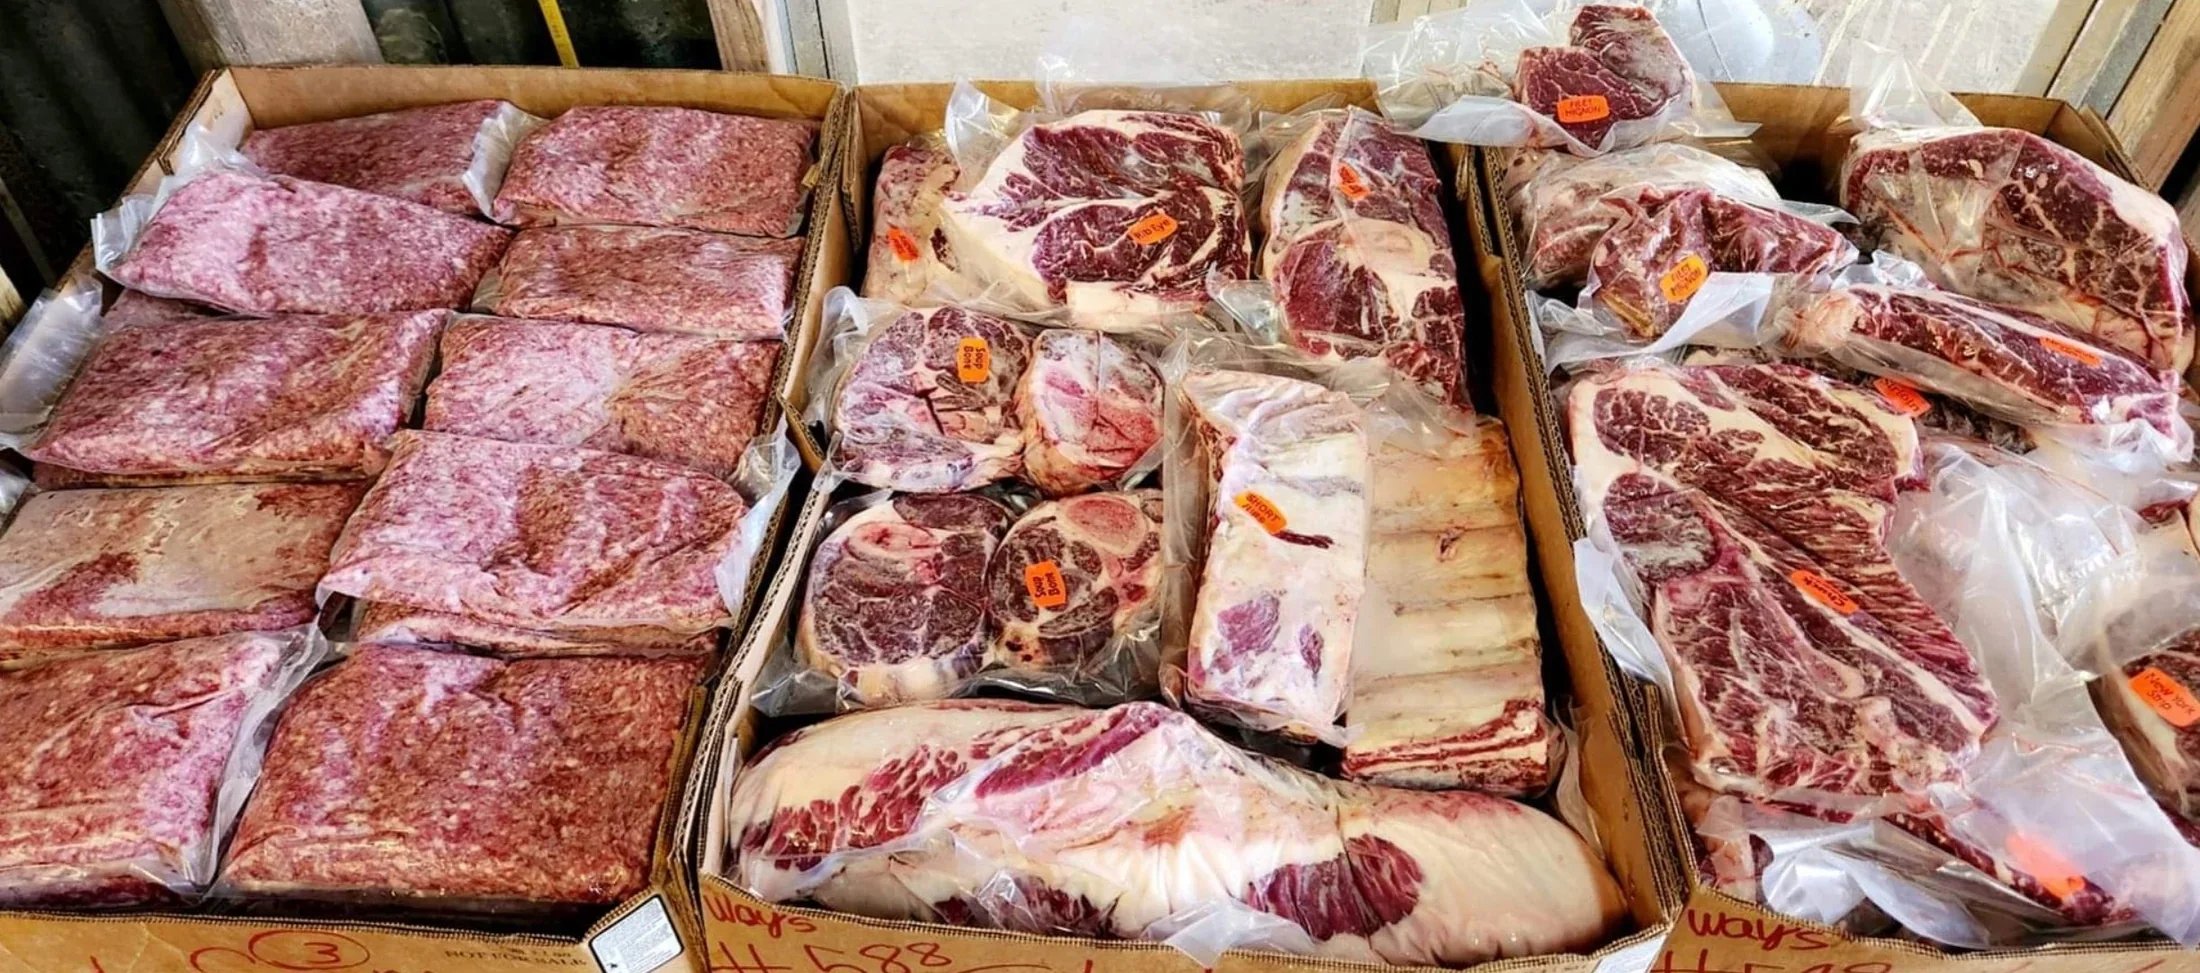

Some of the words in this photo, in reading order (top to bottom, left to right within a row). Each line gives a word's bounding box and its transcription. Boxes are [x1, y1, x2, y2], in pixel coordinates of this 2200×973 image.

[974, 347, 986, 370] Soup
[1246, 494, 1281, 522] SHORT
[1033, 576, 1047, 598] Soup
[2143, 672, 2174, 696] New
[2146, 690, 2172, 710] Strip
[303, 943, 341, 964] 3
